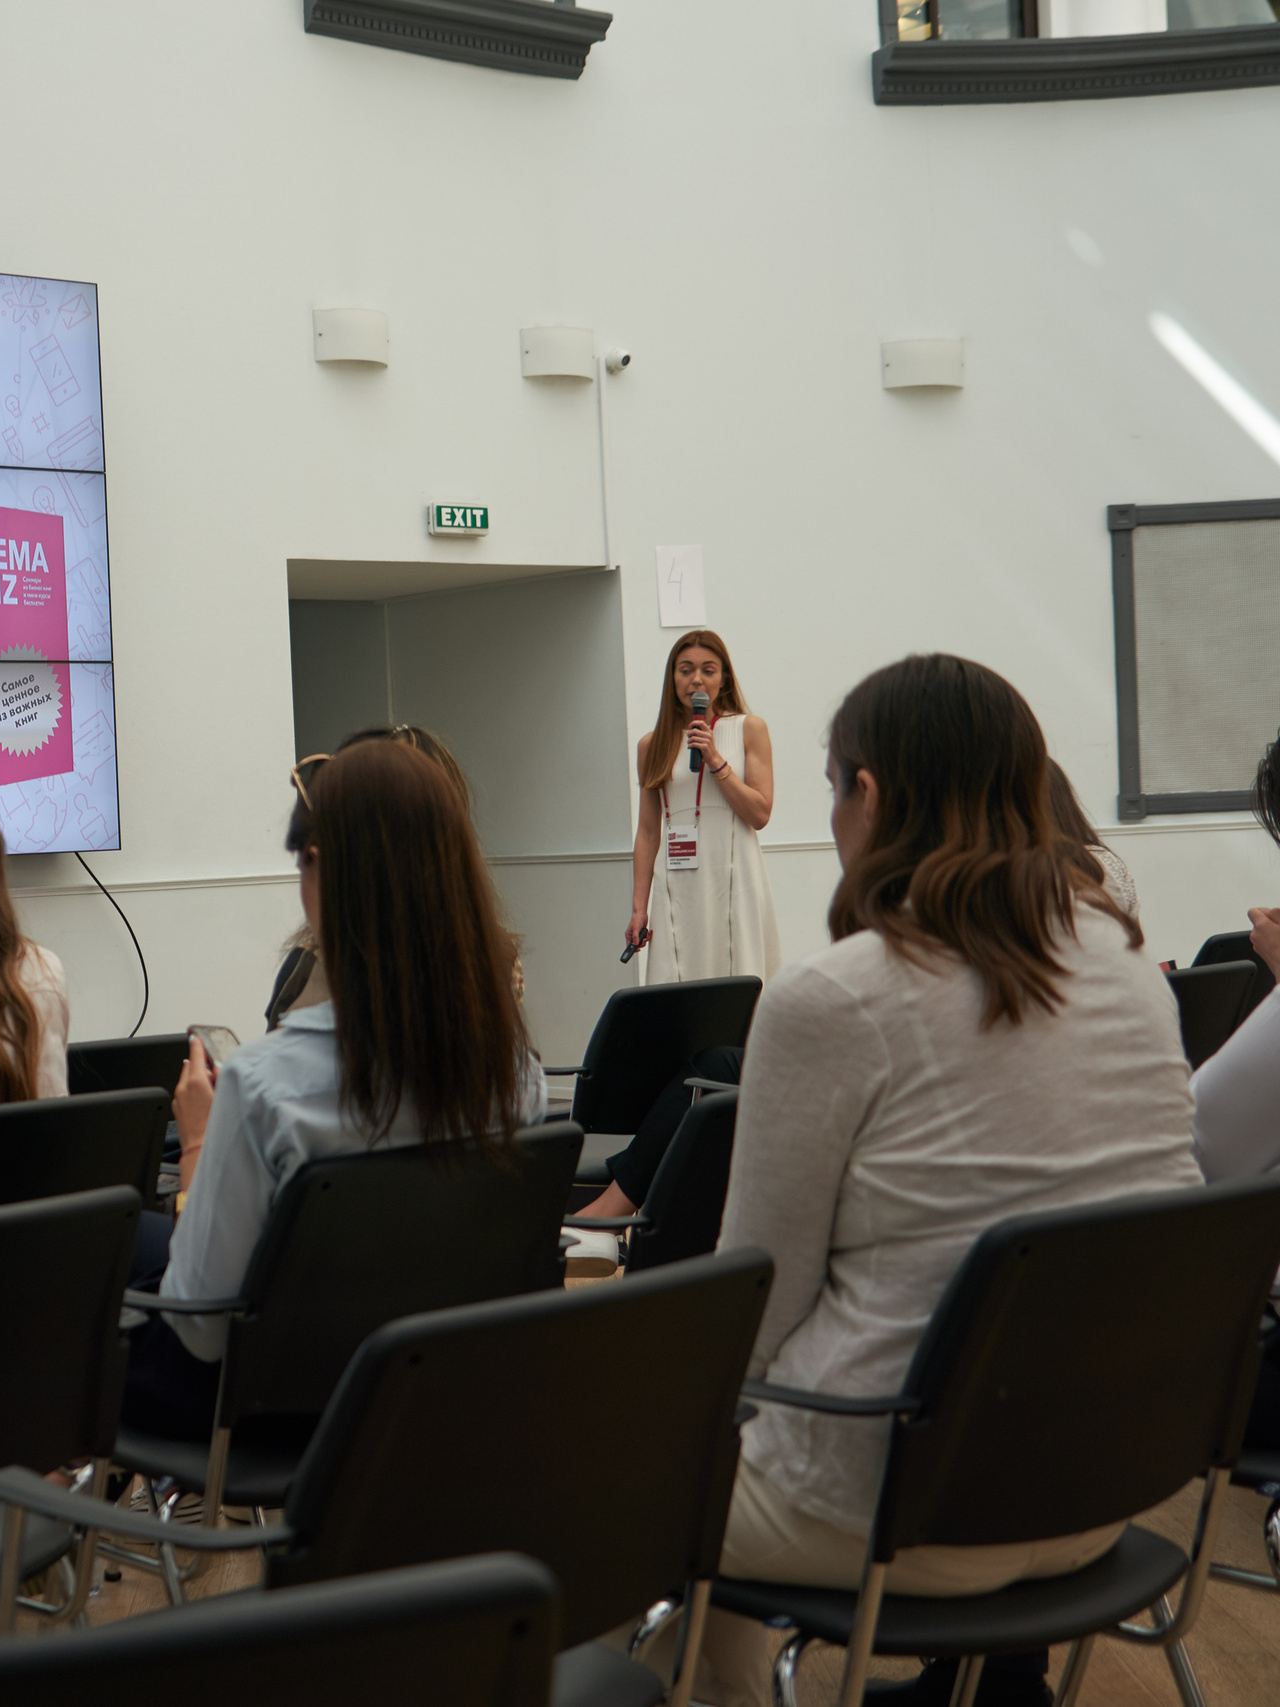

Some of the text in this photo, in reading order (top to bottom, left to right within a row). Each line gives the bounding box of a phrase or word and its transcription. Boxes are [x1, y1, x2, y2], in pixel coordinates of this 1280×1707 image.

[440, 507, 484, 528] EXIT
[667, 556, 683, 604] 4
[1, 673, 35, 694] Самое
[1, 684, 40, 707] ценное
[9, 692, 53, 718] важных
[15, 711, 39, 729] книг
